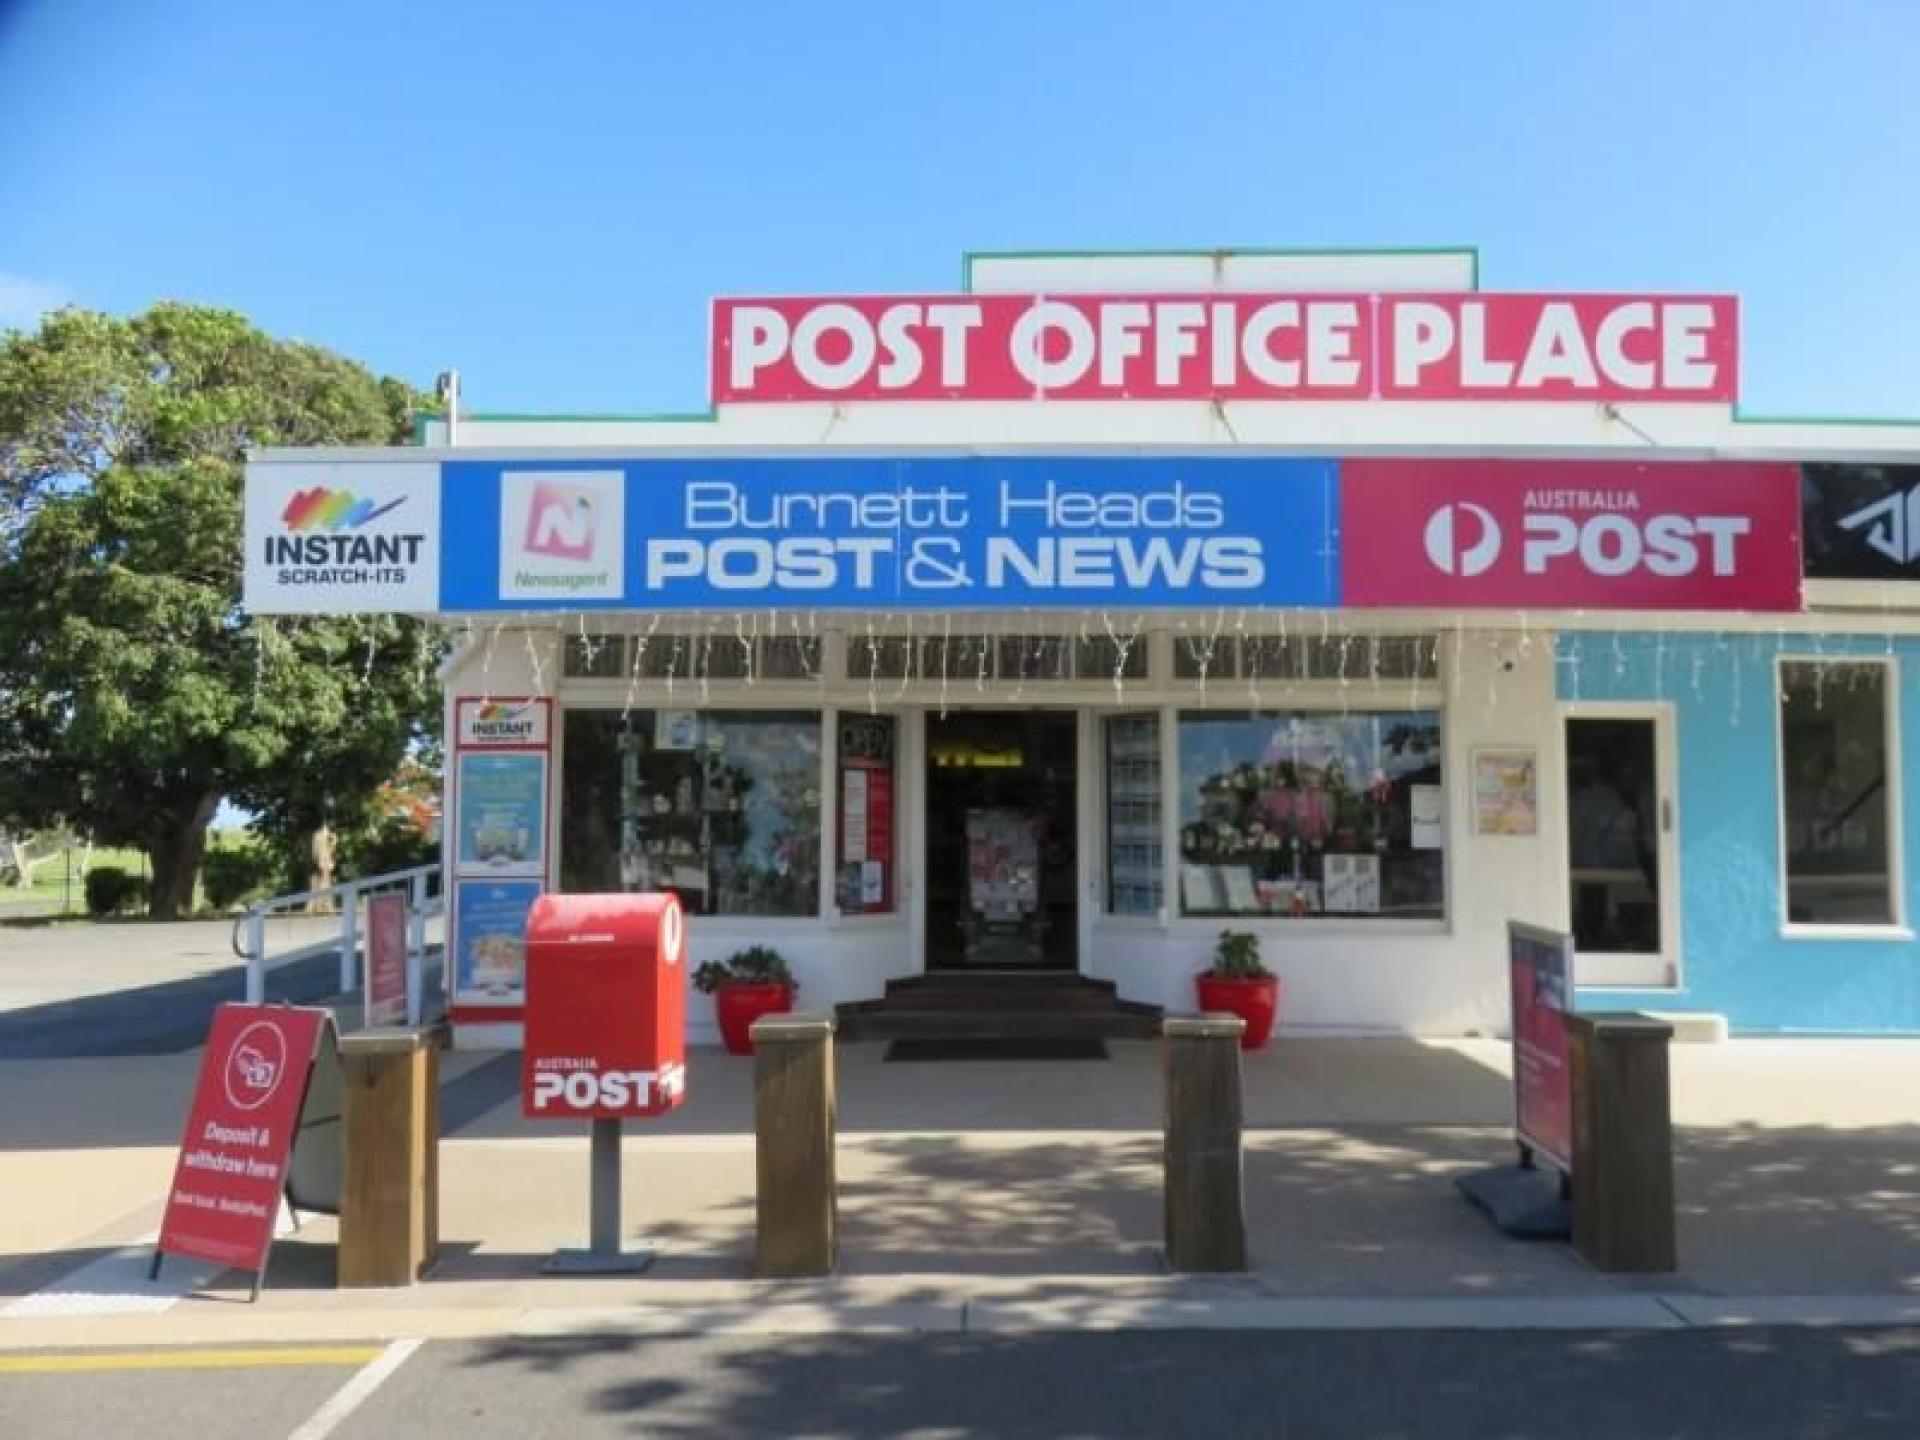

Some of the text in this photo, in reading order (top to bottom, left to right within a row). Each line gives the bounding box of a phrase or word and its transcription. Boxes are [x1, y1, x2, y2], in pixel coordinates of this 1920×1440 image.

[731, 300, 1719, 391] POST OFFICE PLACE
[685, 480, 1224, 530] Burnett Heads
[1524, 489, 1640, 511] AUSTRALIA
[265, 535, 425, 566] INSTANT
[1523, 514, 1752, 577] POST
[277, 568, 407, 584] SCRATCH-ITS
[646, 537, 1266, 590] POST & NEWS
[514, 571, 608, 590] Newsagent
[534, 1071, 658, 1110] POST
[203, 1120, 258, 1147] Deposit
[184, 1149, 278, 1180] withdraw here
